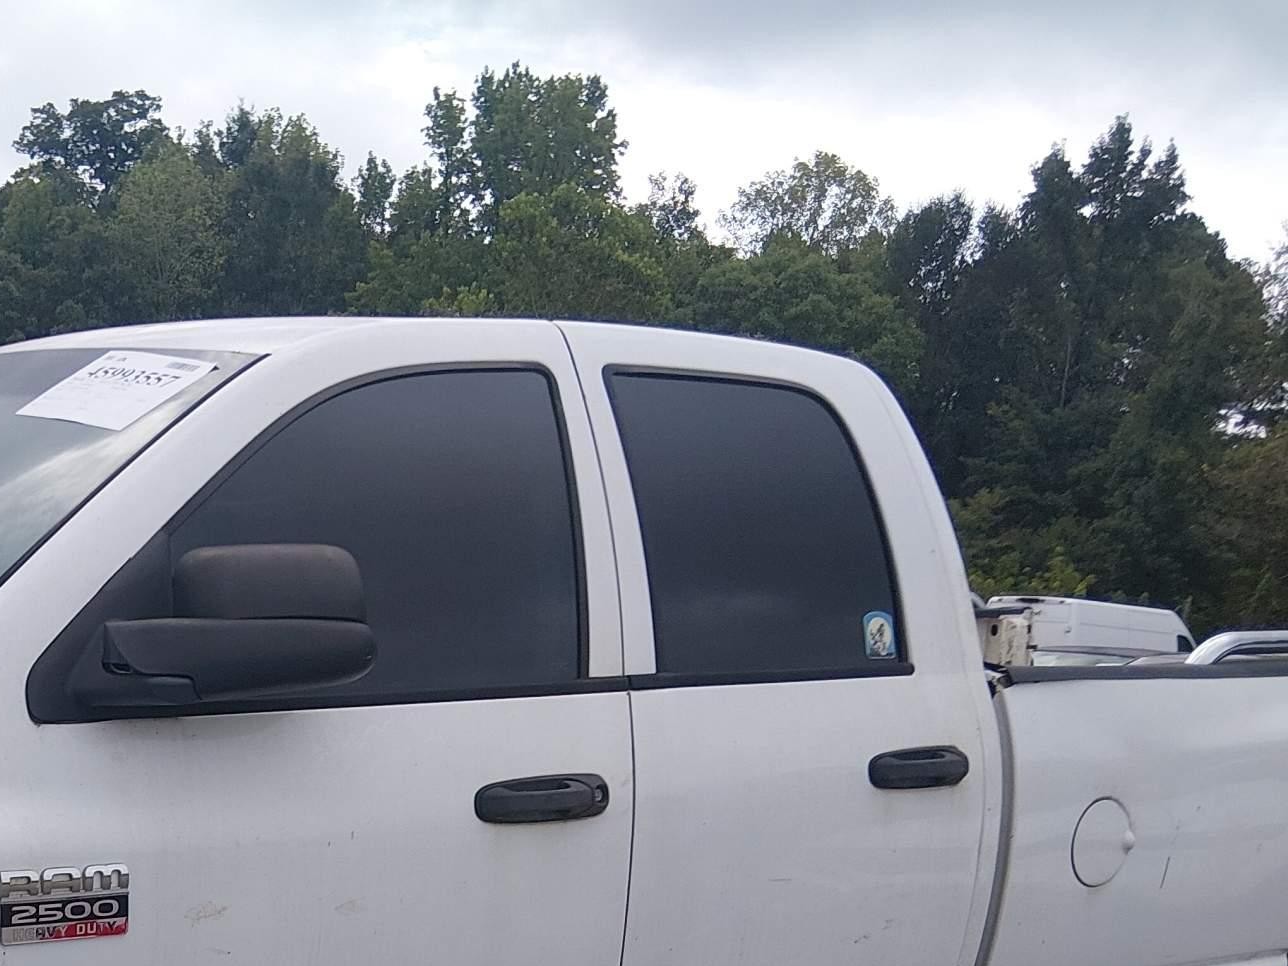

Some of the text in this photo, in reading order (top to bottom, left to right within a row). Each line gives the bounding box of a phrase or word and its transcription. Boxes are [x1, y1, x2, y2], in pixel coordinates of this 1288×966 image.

[0, 863, 129, 898] RAM
[11, 899, 120, 924] 2500
[76, 920, 117, 936] DUTY
